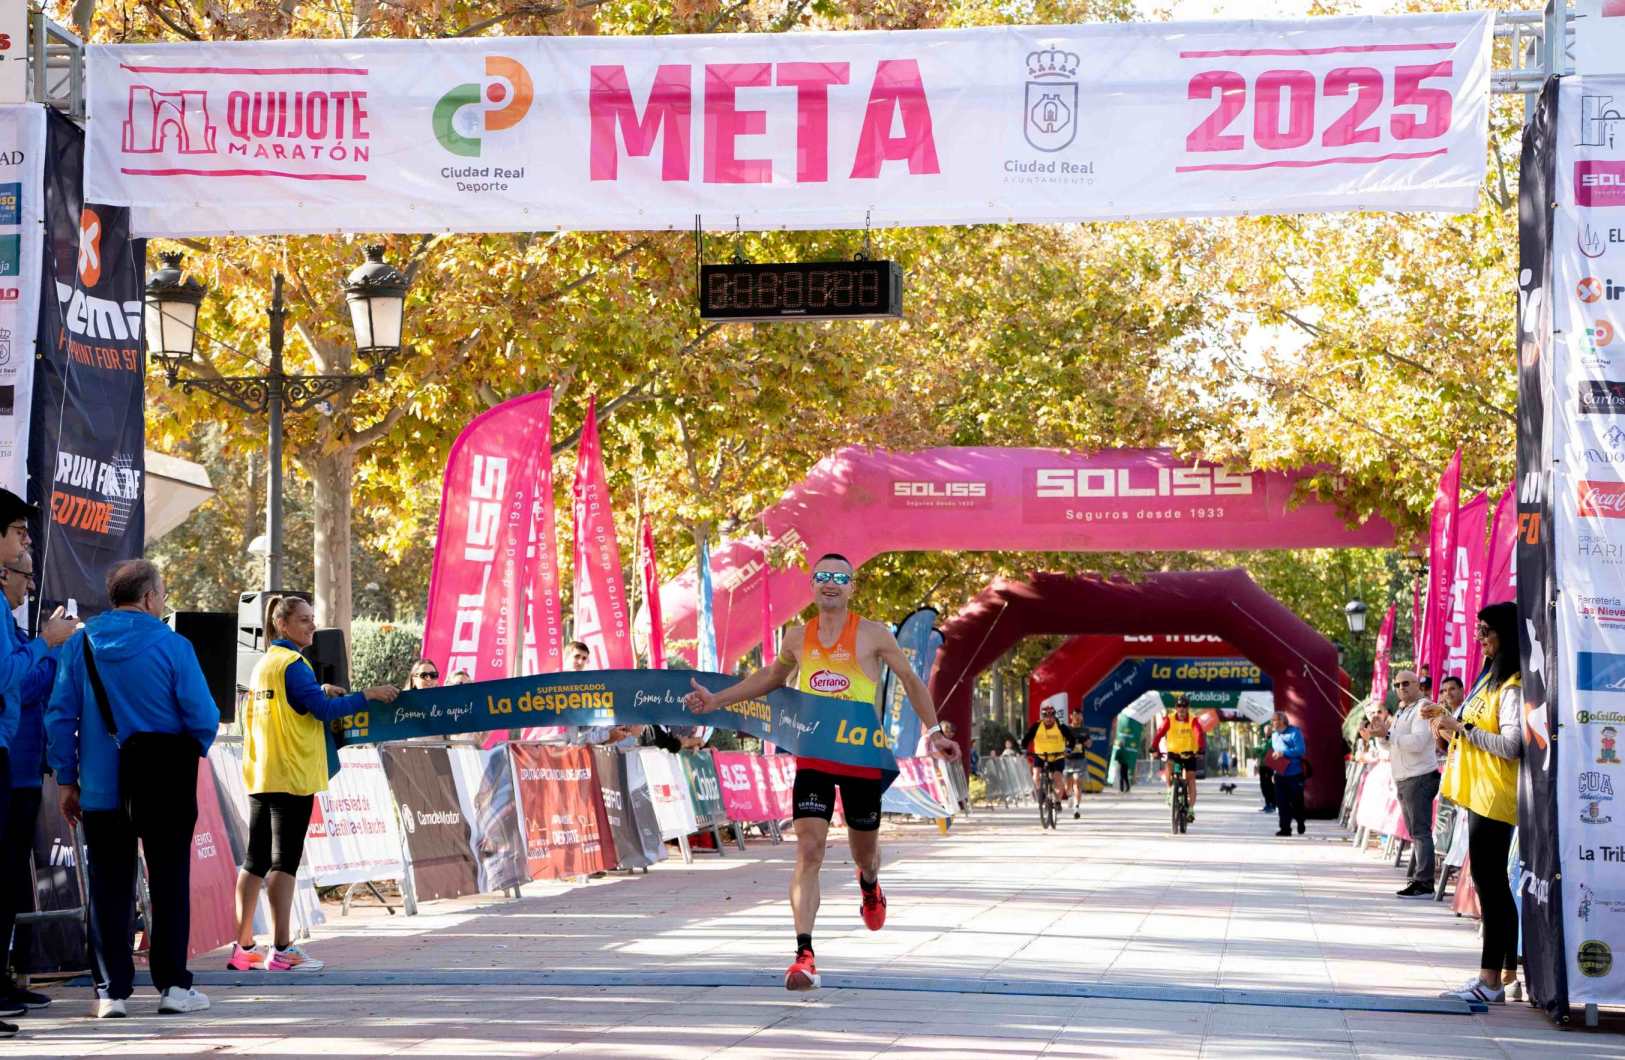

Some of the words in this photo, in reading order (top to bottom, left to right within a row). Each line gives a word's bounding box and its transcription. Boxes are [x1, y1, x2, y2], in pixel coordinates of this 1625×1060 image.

[226, 89, 370, 142] QUIJOTE
[1186, 59, 1454, 152] 2025
[589, 58, 941, 184] META
[228, 142, 369, 163] MARATÓN
[440, 166, 490, 180] Ciudad
[493, 166, 525, 179] Real
[1003, 159, 1057, 176] Ciudad
[1060, 160, 1095, 175] Real
[456, 180, 508, 194] Deporte
[1003, 175, 1095, 185] AYUNTAMIENTO
[95, 348, 122, 369] FOR
[54, 451, 97, 490] RUN
[894, 481, 987, 497] SOLISS
[1035, 467, 1253, 498] SOLISS
[587, 483, 600, 517] 1933
[51, 491, 113, 535] FUTURE
[1065, 509, 1129, 522] Seguros
[1136, 508, 1181, 520] desde
[1189, 508, 1225, 519] 1933
[596, 526, 612, 570] desde
[606, 576, 625, 638] Seguros
[813, 676, 848, 688] Serrano
[1151, 664, 1170, 679] La
[1175, 663, 1261, 682] despensa
[487, 694, 513, 715] La
[517, 690, 614, 716] despensa
[835, 719, 868, 746] La
[1578, 845, 1595, 862] La
